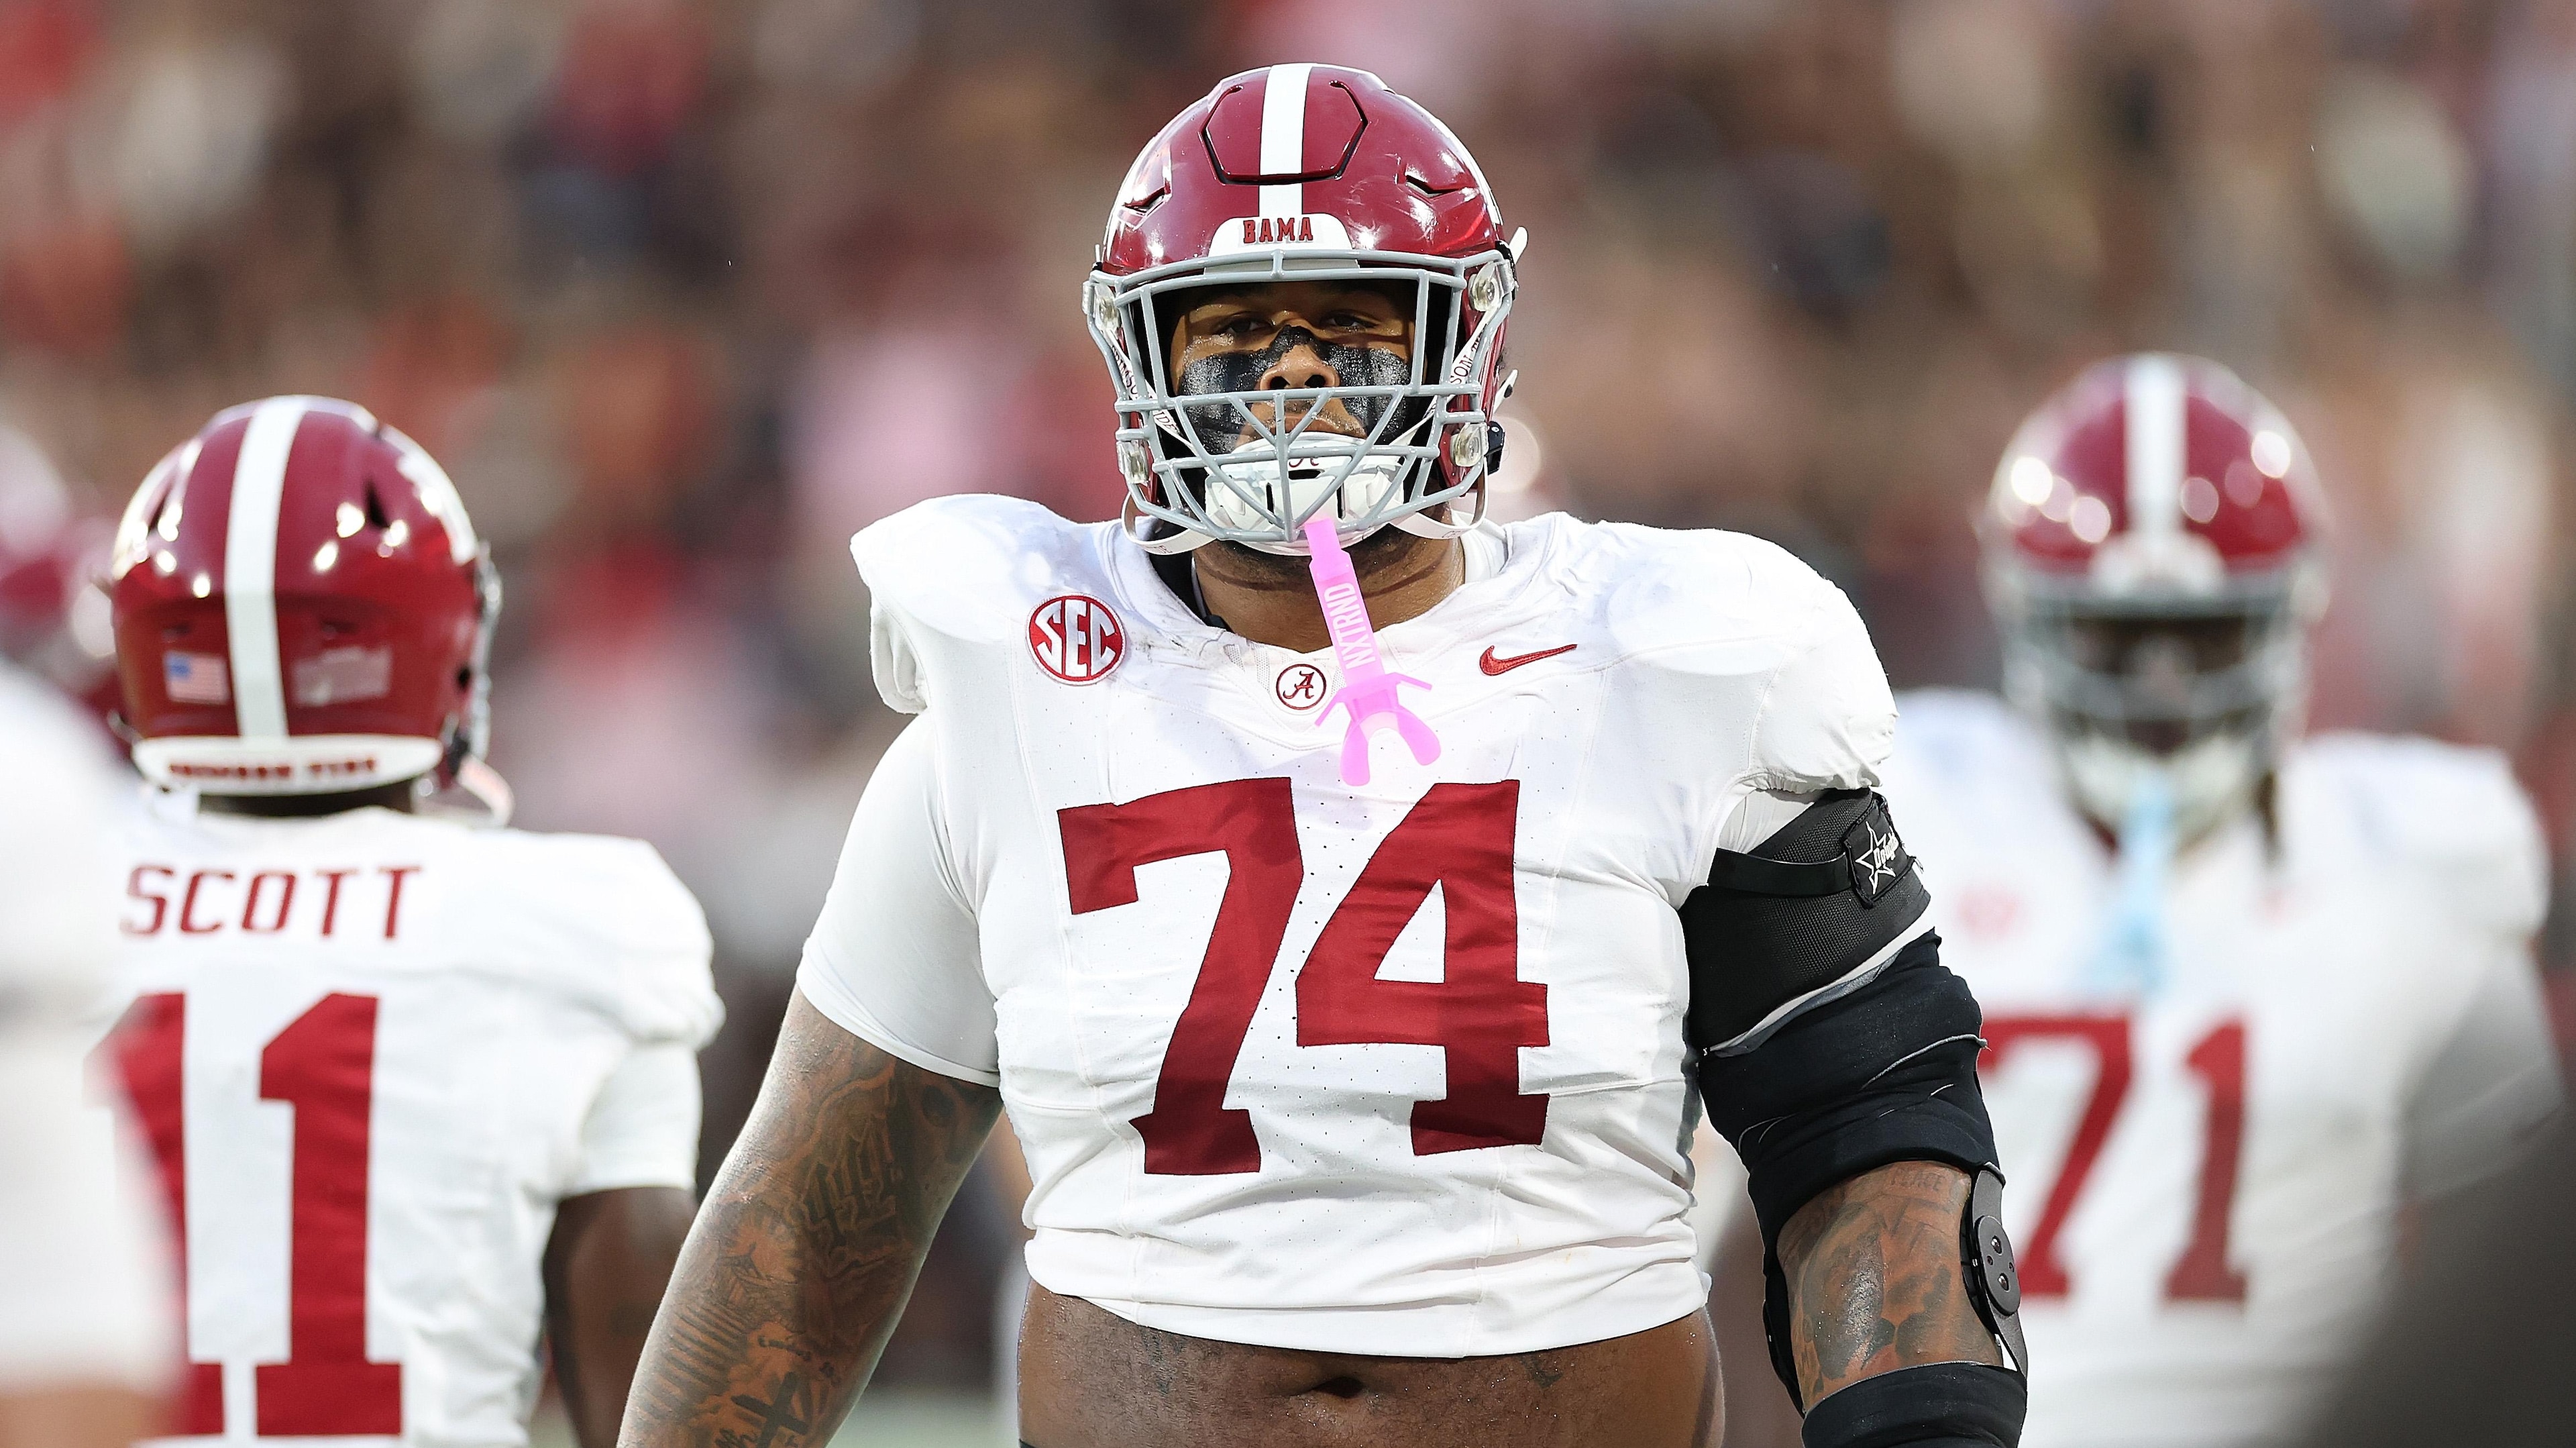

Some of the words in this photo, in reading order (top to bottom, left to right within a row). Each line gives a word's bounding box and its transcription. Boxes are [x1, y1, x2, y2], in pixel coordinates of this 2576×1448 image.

[1243, 217, 1313, 244] BAMA
[1034, 599, 1116, 678] SEC
[1324, 582, 1377, 670] NXTRND
[1282, 670, 1315, 699] A
[119, 862, 423, 941] SCOTT
[1057, 776, 1551, 1176] 74
[1975, 1010, 2250, 1303] 71
